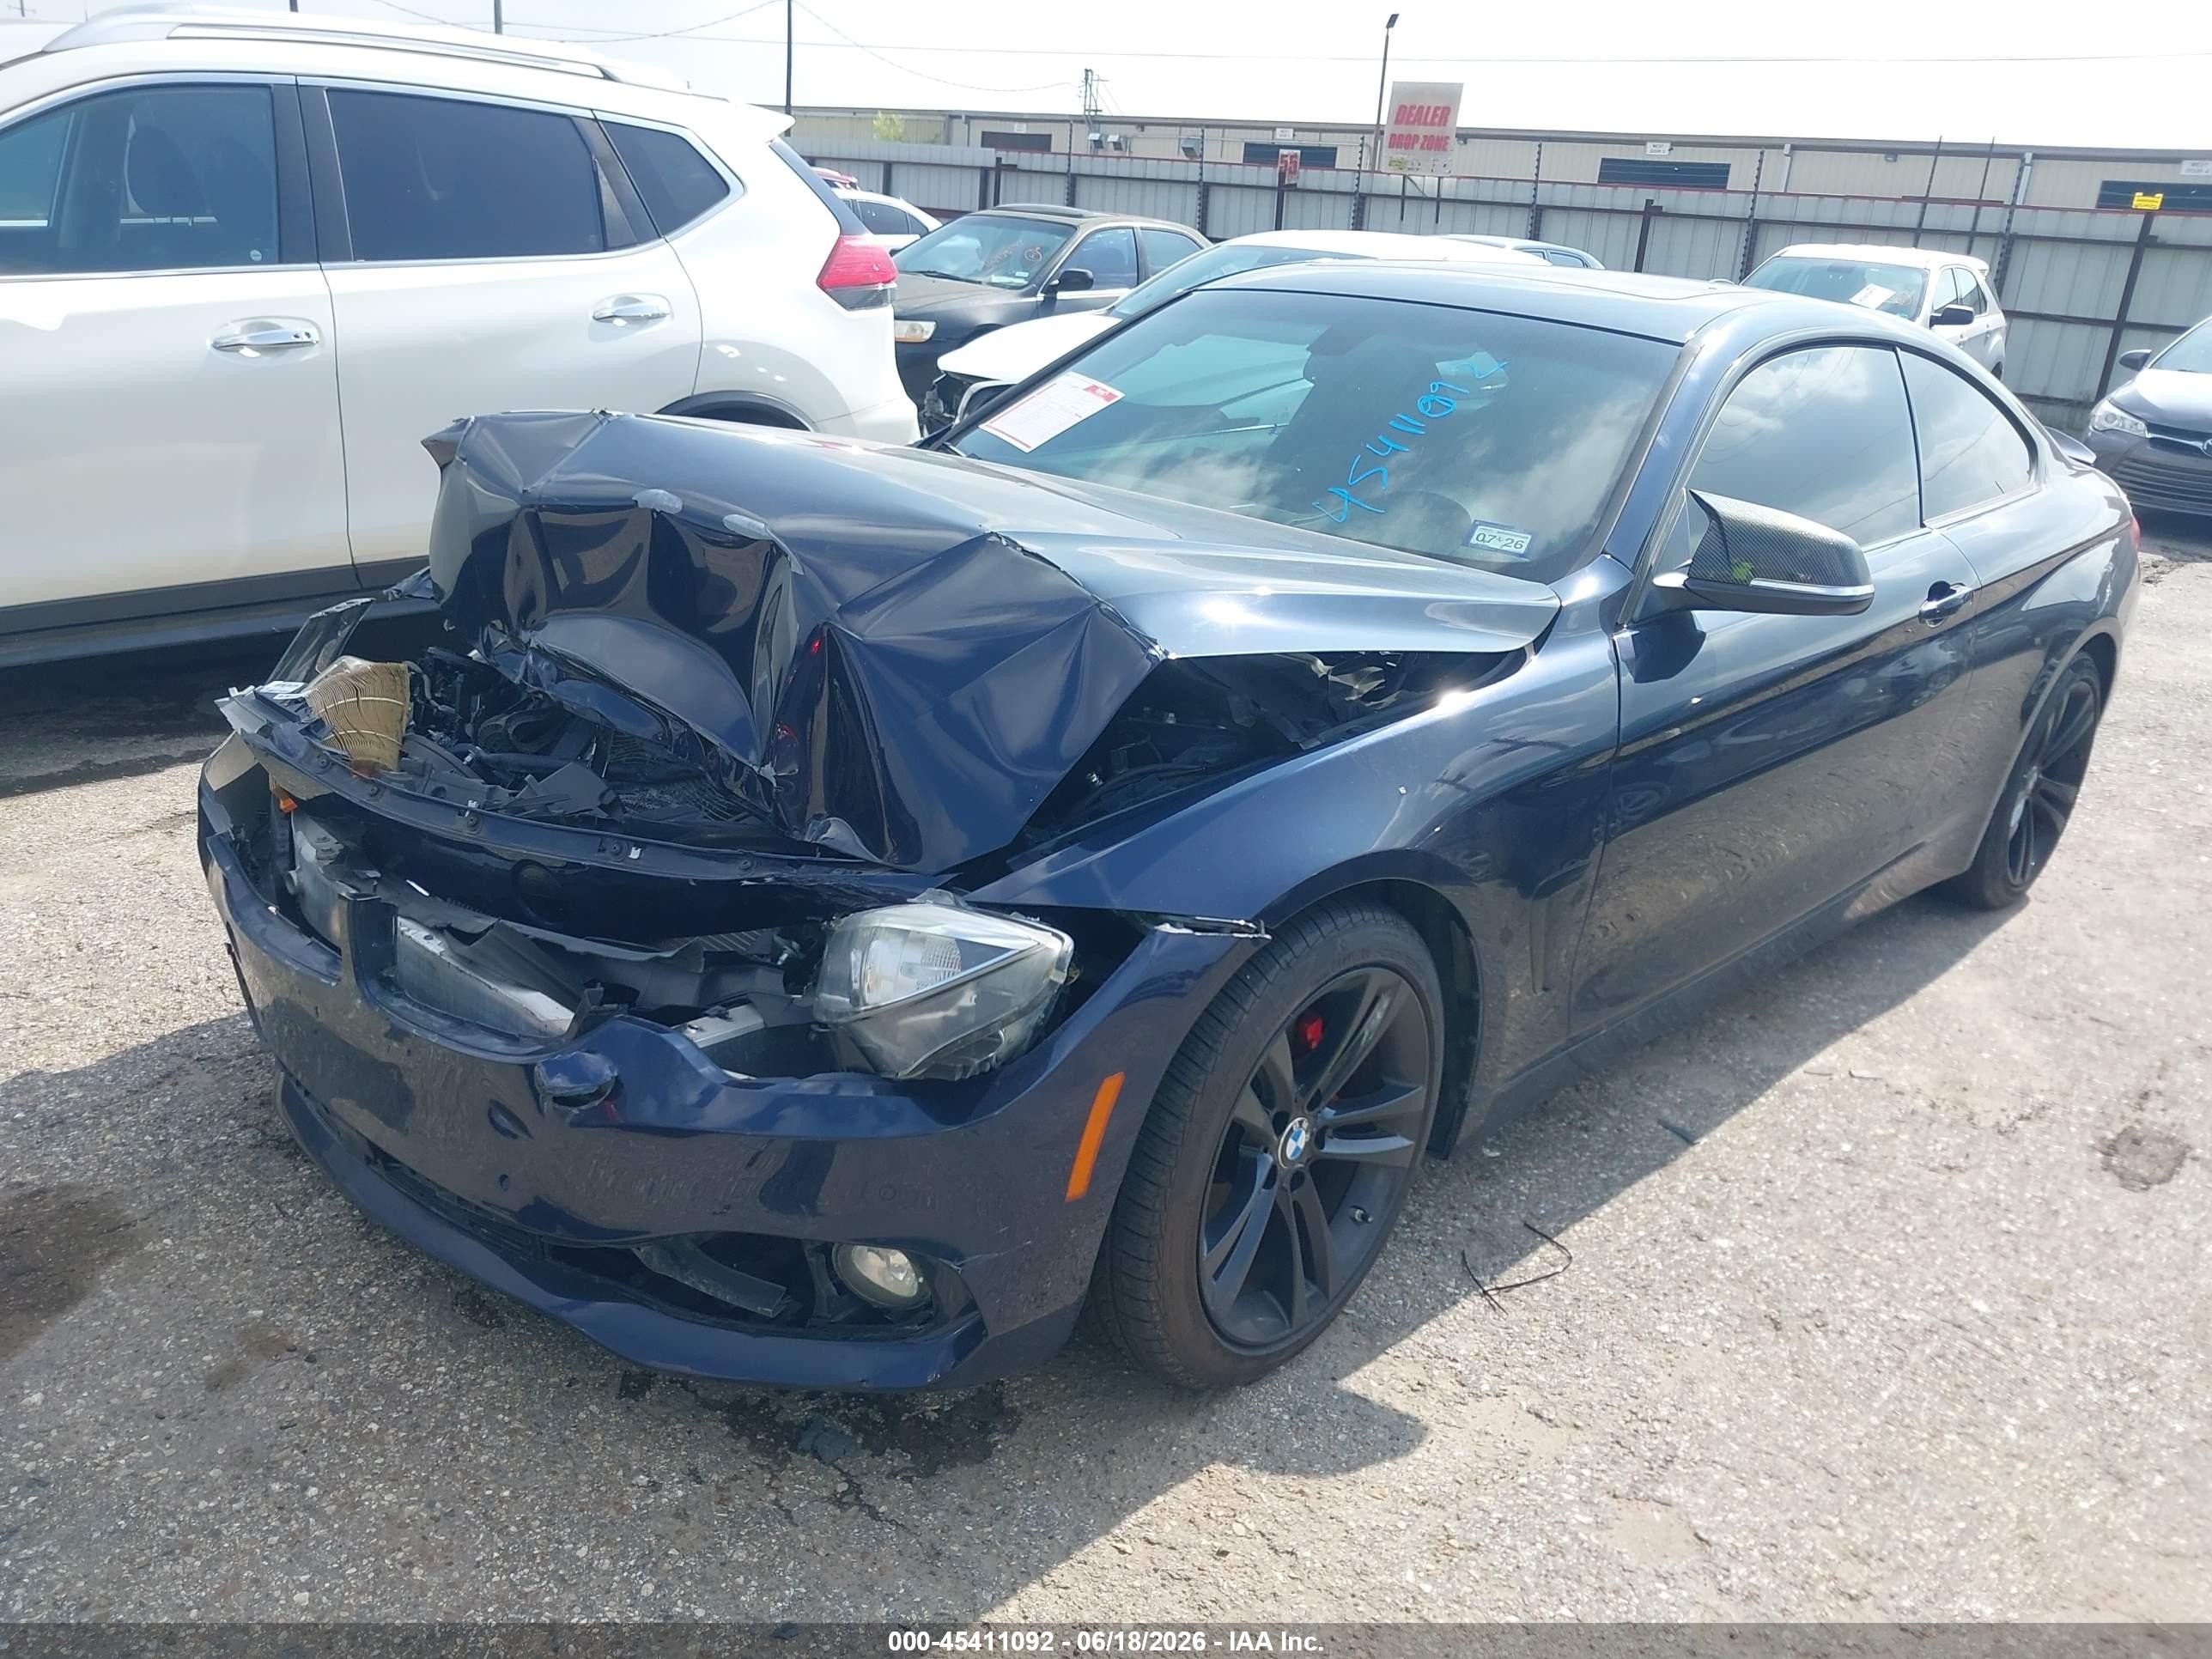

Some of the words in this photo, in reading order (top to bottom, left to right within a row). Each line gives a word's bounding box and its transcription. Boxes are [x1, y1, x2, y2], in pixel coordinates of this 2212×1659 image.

[1393, 104, 1451, 127] DEALER
[1388, 132, 1419, 150] DROP
[1419, 134, 1450, 152] ZONE
